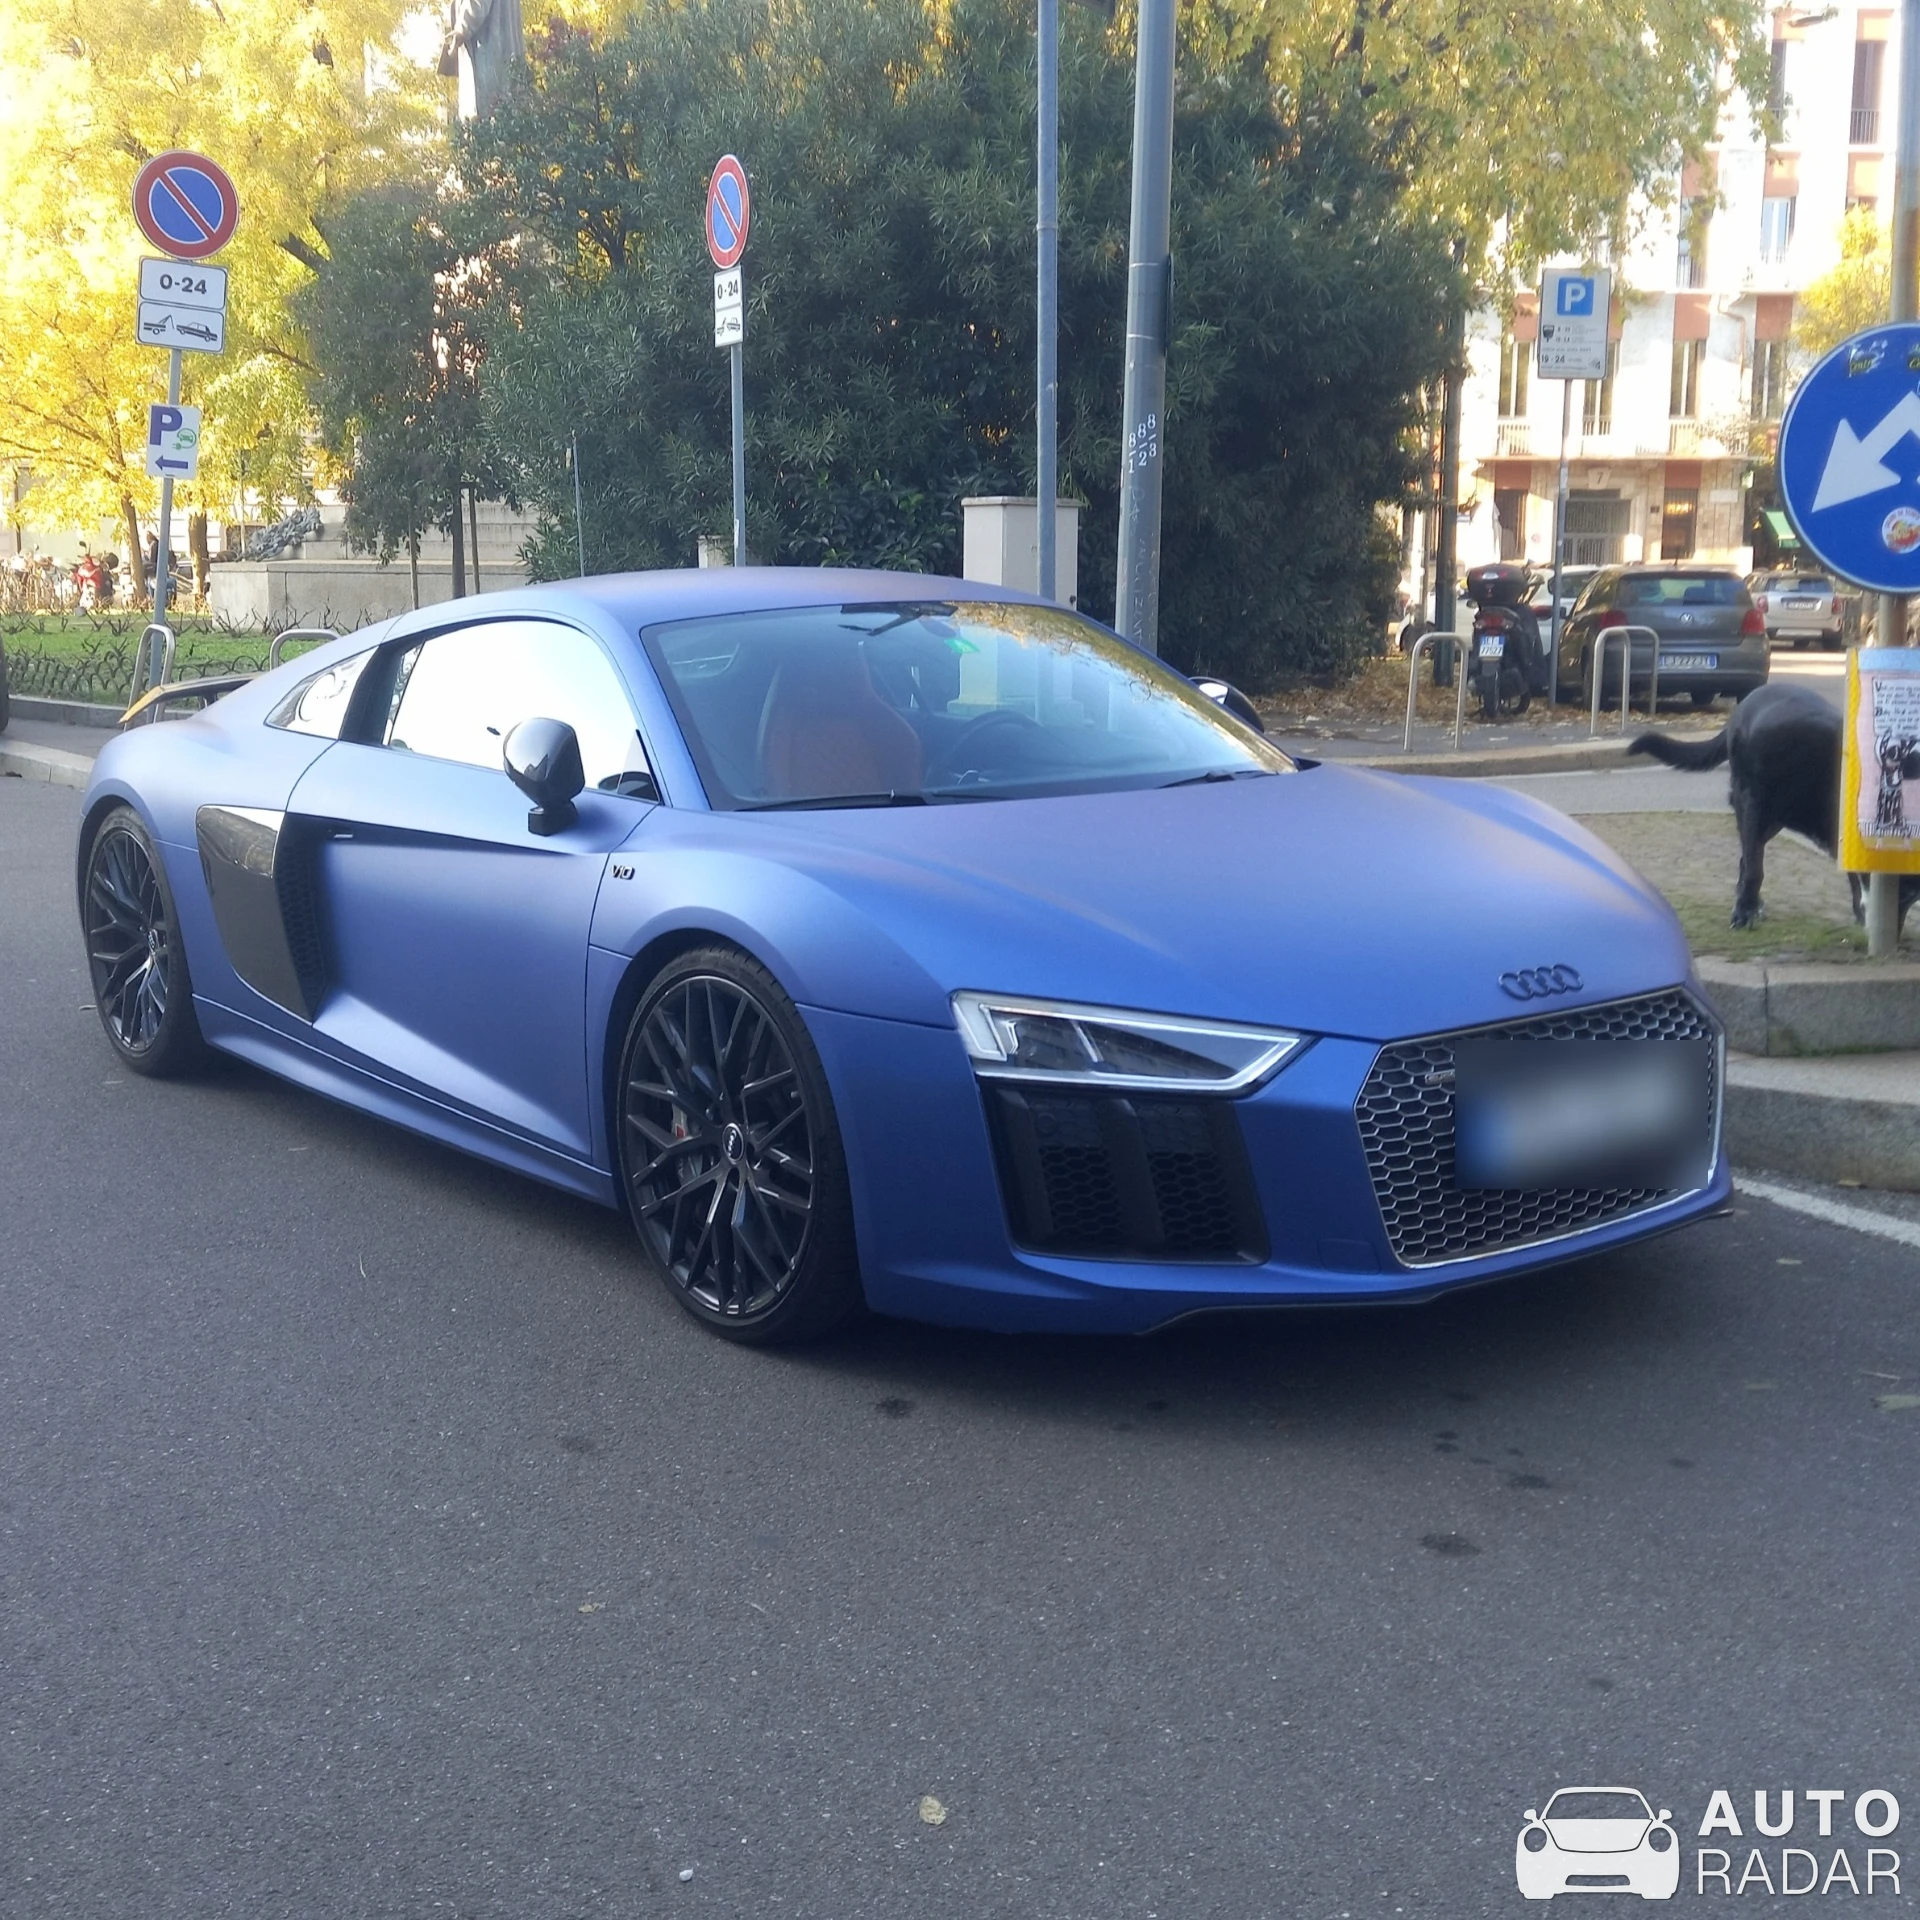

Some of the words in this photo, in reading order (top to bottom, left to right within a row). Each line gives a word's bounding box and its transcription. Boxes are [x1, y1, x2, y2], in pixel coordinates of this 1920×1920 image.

[159, 273, 208, 295] 0-24
[1564, 282, 1587, 312] P
[149, 405, 183, 446] P
[612, 864, 636, 881] V10
